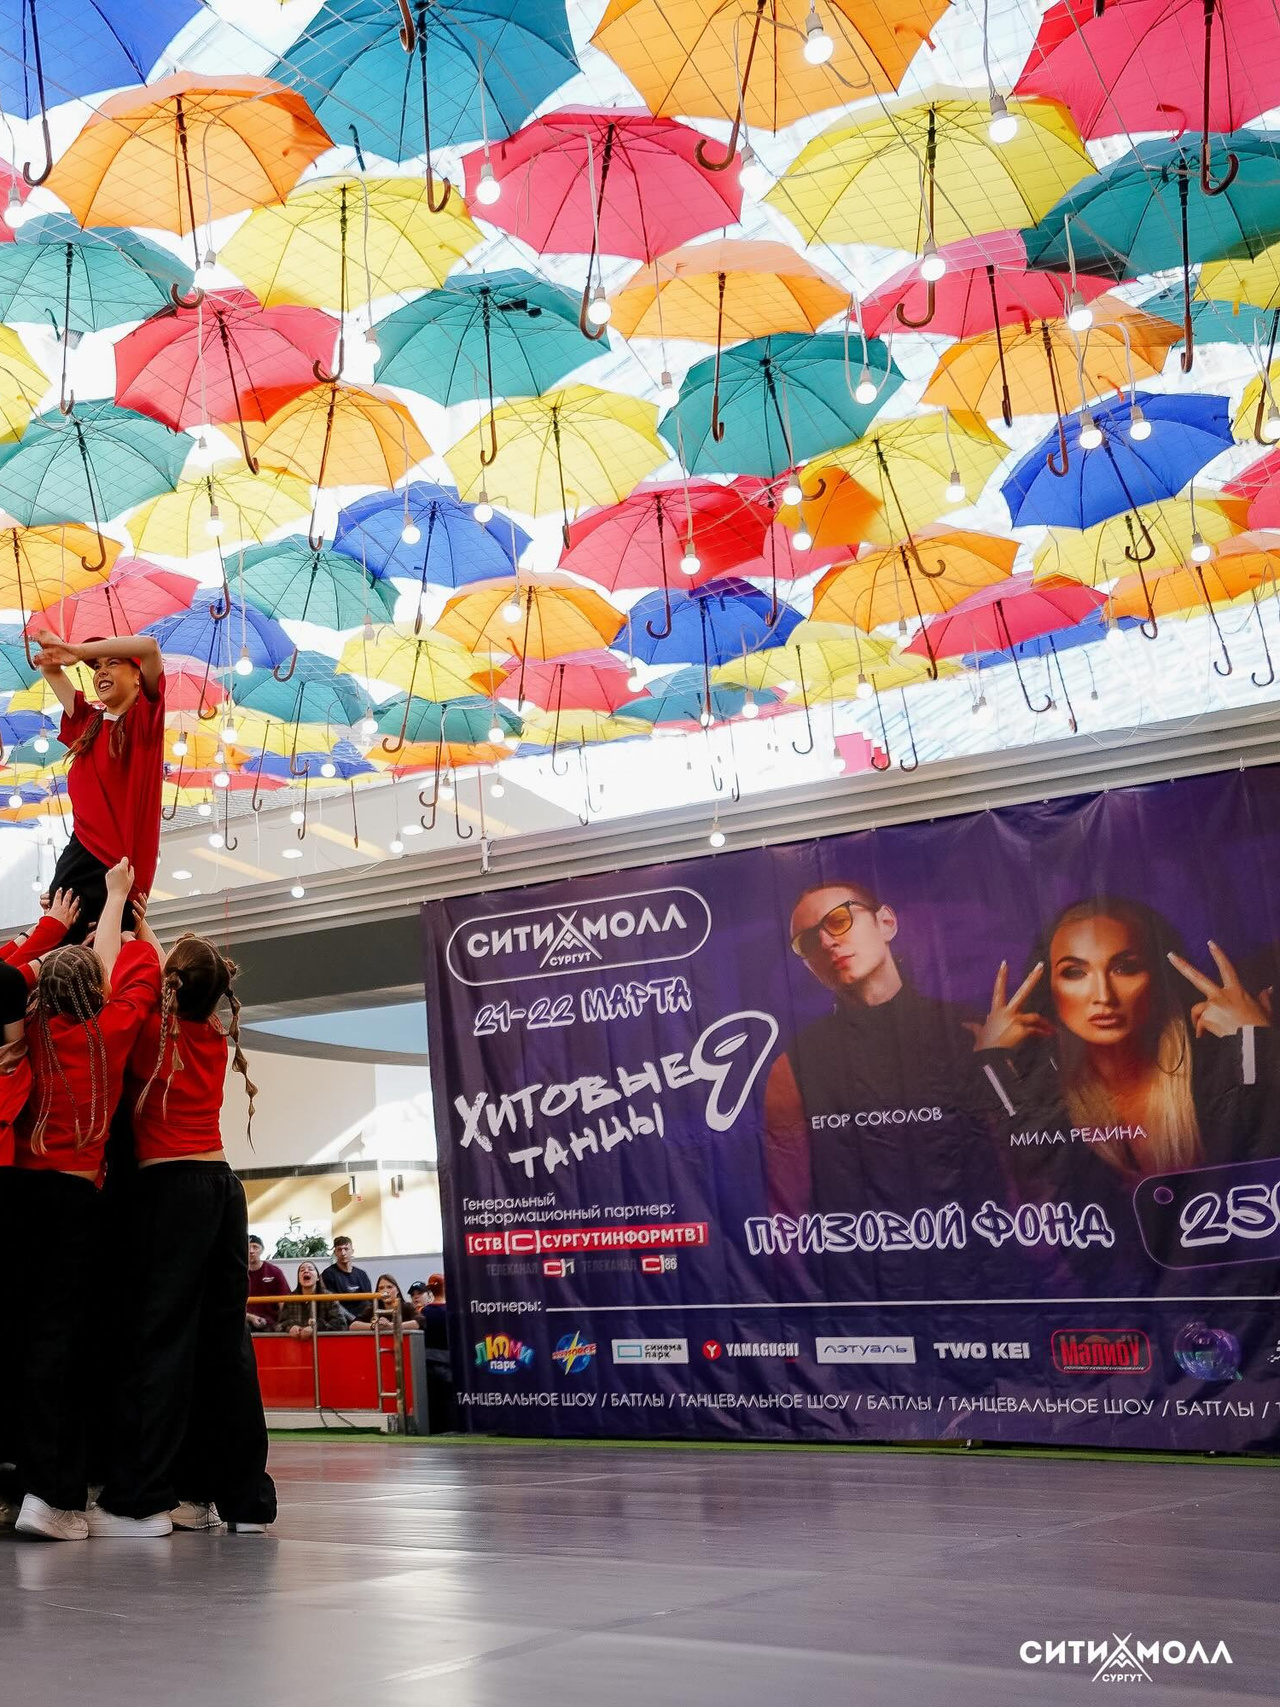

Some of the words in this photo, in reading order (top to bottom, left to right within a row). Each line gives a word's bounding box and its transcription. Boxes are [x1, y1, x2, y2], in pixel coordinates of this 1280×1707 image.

[549, 952, 592, 967] СУРГУТ
[473, 995, 574, 1036] 21-22
[581, 976, 692, 1023] МАРТА
[455, 1052, 700, 1152] ХИТОВЫЕ
[811, 1113, 851, 1130] ЕГОР
[854, 1106, 943, 1127] СОКОЛОВ
[509, 1102, 664, 1179] ТАНЦЫ
[1010, 1130, 1066, 1147] МИЛА
[1070, 1124, 1147, 1143] РЕДИНА
[463, 1192, 556, 1212] Генеральный
[464, 1204, 601, 1227] информационный
[605, 1203, 676, 1220] партнер:
[1180, 1181, 1280, 1248] 25
[744, 1202, 966, 1255] ПРИЗОВОЙ
[972, 1200, 1115, 1249] ФОНД
[470, 1300, 542, 1315] Партнеры:
[644, 1351, 671, 1360] парк
[725, 1342, 800, 1357] YAMAGUCHI
[933, 1342, 987, 1359] TWO
[991, 1342, 1031, 1359] KEI
[490, 1360, 516, 1372] парк
[457, 1392, 559, 1407] ТАНЦЕВАЛЬНОЕ
[562, 1392, 597, 1407] ШОУ
[611, 1393, 665, 1407] БАТТЛЫ
[679, 1393, 803, 1410] ТАНЦЕВАЛЬНОЕ
[807, 1394, 850, 1410] ШОУ
[867, 1395, 932, 1411] БАТТЛЫ
[949, 1396, 1099, 1414] ТАНЦЕВАЛЬНОЕ
[1103, 1398, 1154, 1415] ШОУ
[1175, 1401, 1254, 1417] БАТТЛЫ
